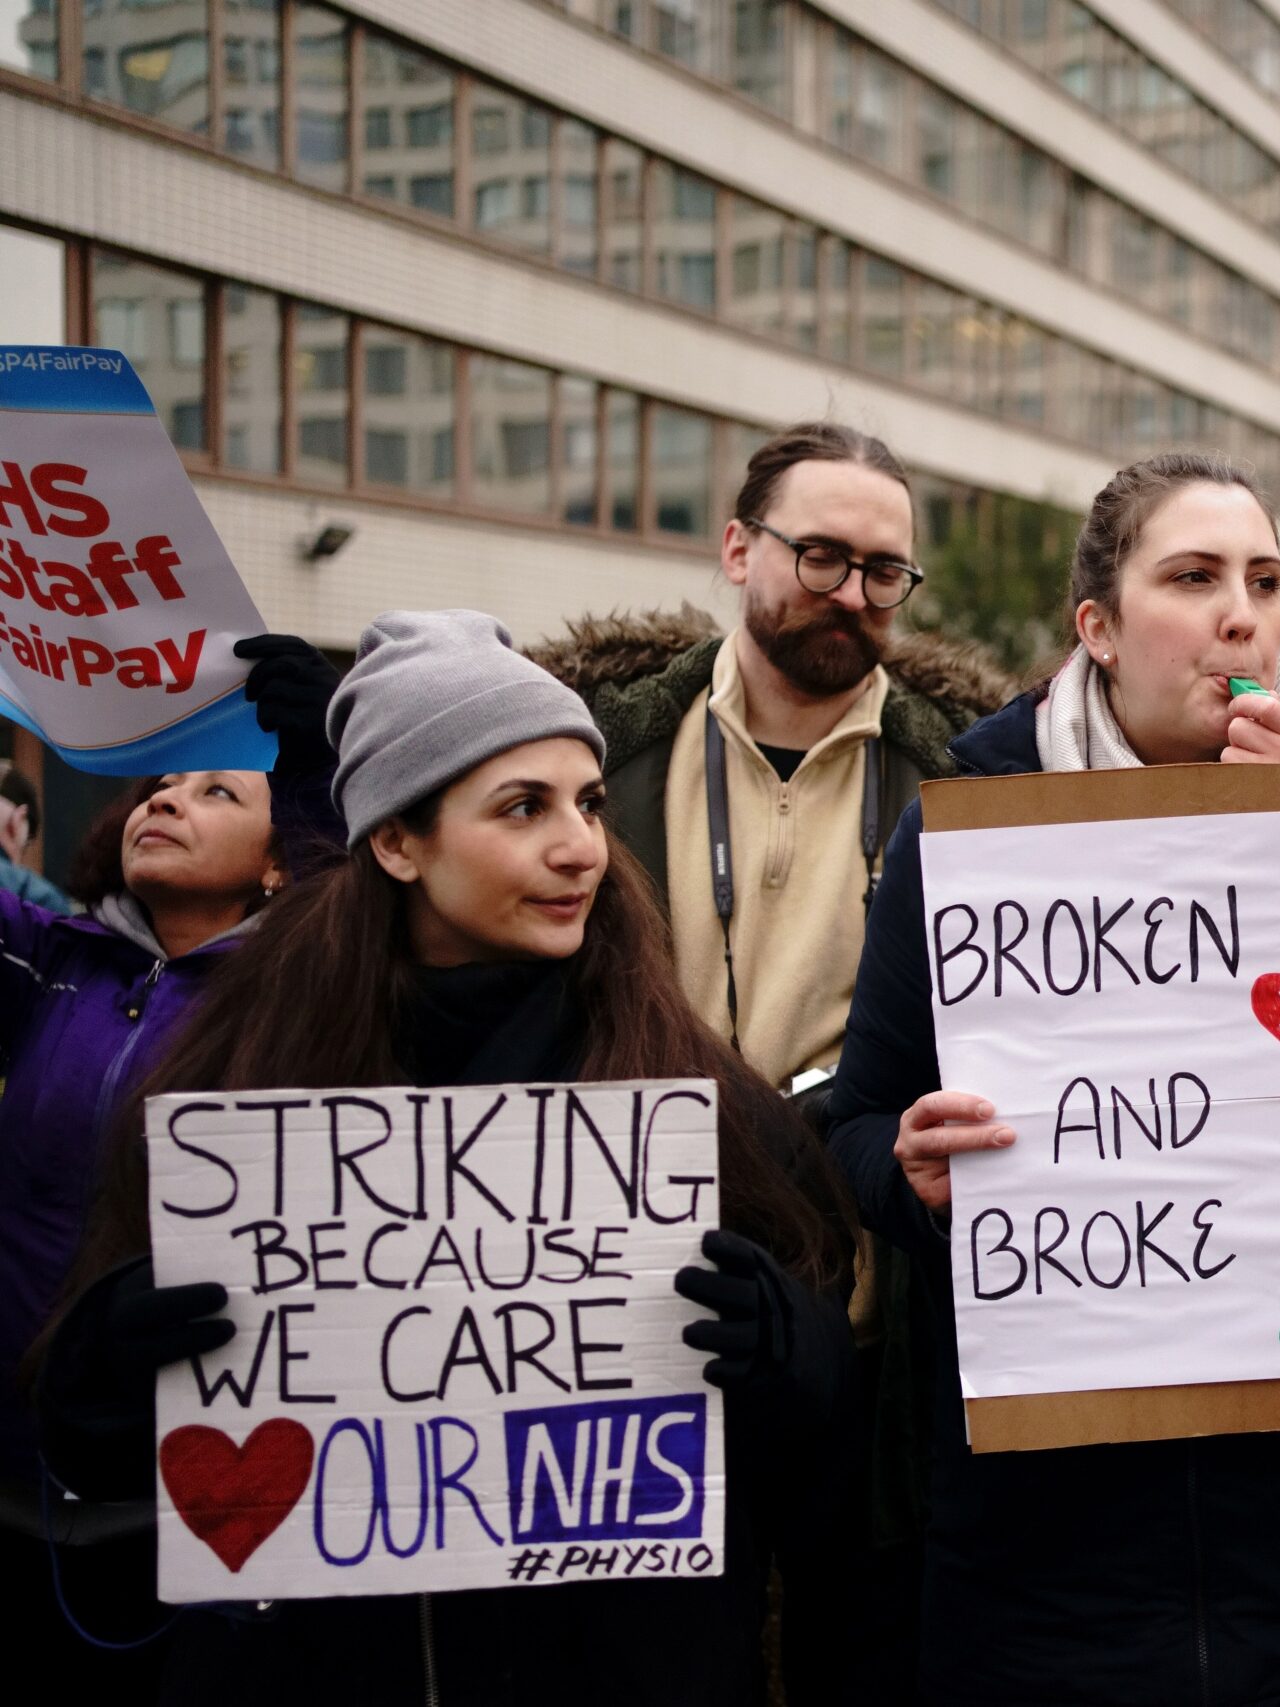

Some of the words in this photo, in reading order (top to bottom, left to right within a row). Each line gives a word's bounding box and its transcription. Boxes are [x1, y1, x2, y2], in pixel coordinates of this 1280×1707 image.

[933, 884, 1240, 1007] BROKEN
[161, 1087, 716, 1226] STRIKING
[1053, 1071, 1211, 1164] AND
[230, 1219, 634, 1296] BECAUSE
[970, 1198, 1238, 1301] BROKE
[189, 1302, 337, 1408] WE
[381, 1297, 633, 1402] CARE
[313, 1417, 505, 1567] OUR
[516, 1410, 698, 1536] NHS
[507, 1543, 714, 1582] #PHYSIO
